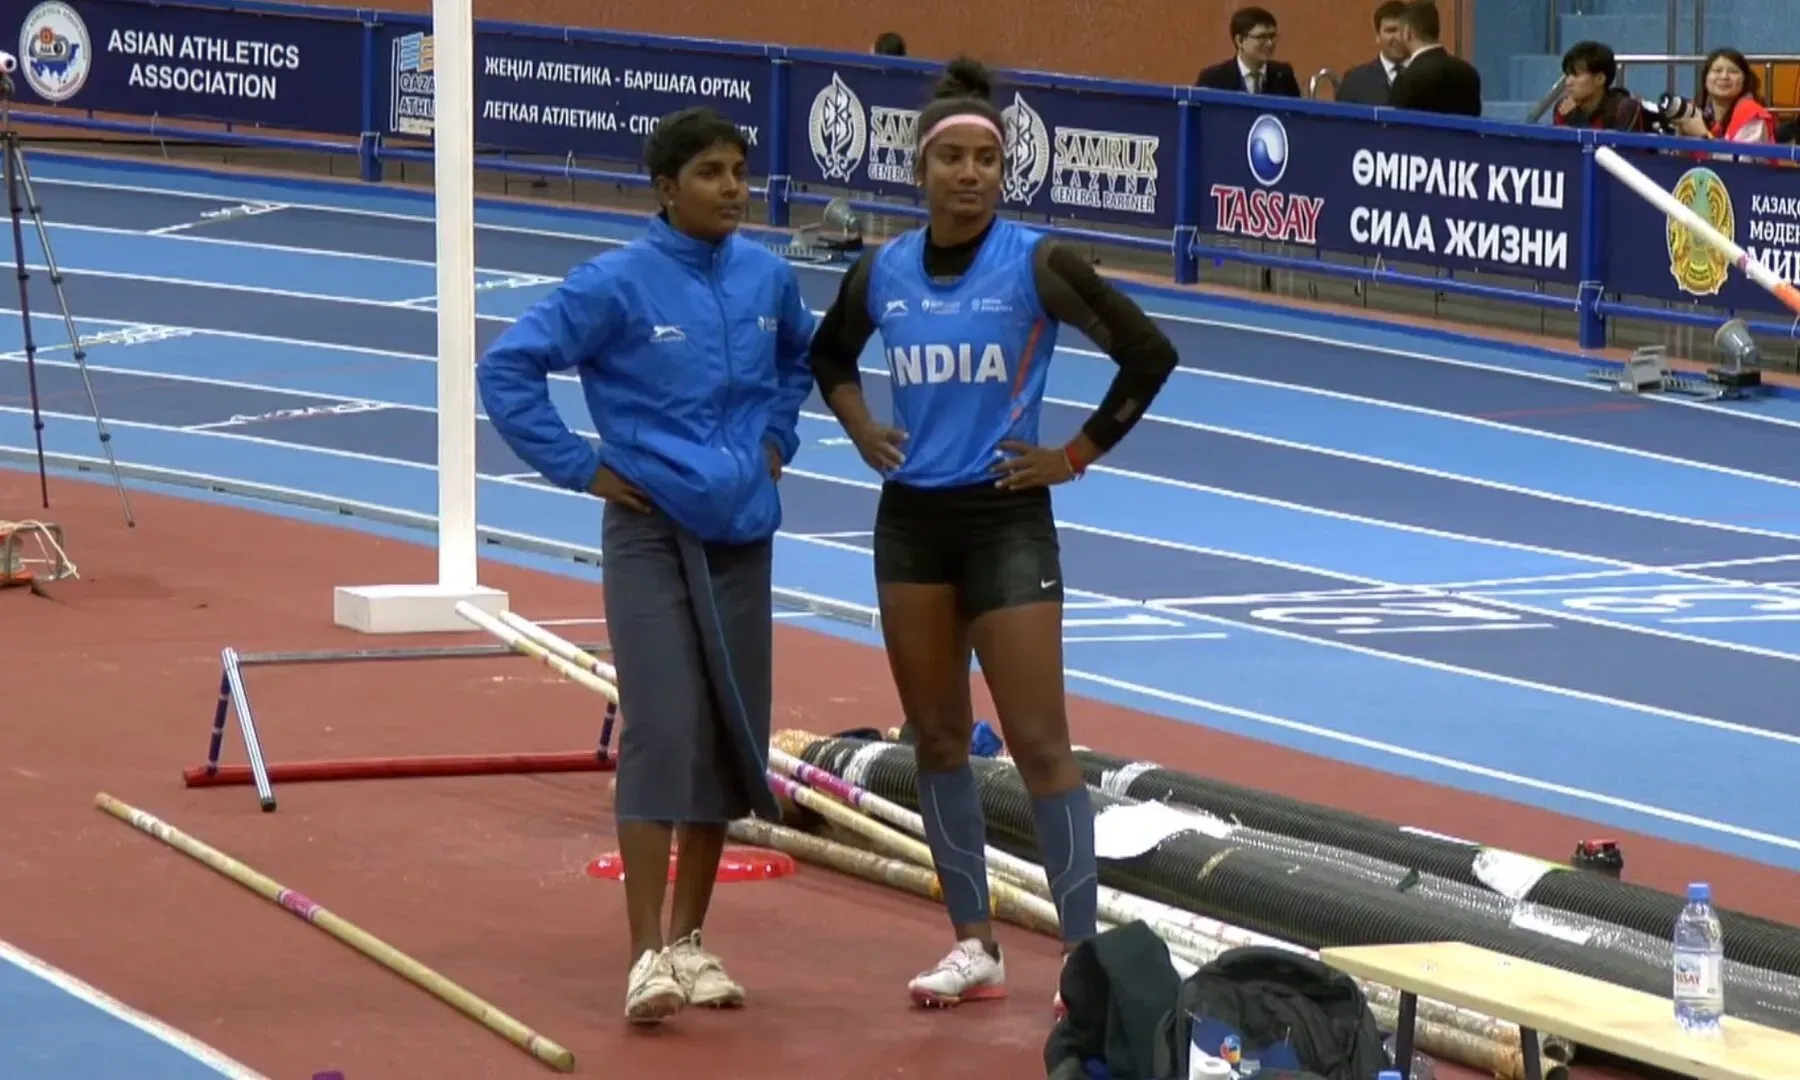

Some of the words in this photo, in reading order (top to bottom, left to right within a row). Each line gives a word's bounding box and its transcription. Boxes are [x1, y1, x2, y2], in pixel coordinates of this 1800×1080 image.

[107, 28, 174, 58] ASIAN
[179, 35, 300, 69] ATHLETICS
[128, 63, 277, 100] ASSOCIATION
[484, 56, 533, 82] ЖЕҢІЛ
[536, 61, 612, 87] АТЛЕТИКА
[624, 69, 697, 94] БАРШАҒА
[700, 76, 751, 104] ОРТАҚ
[483, 99, 539, 123] ЛЕГКАЯ
[542, 106, 617, 132] АТЛЕТИКА
[1055, 128, 1159, 176] SAMRUK
[1050, 185, 1101, 208] GENERAL
[1102, 190, 1155, 213] PARTNER
[1210, 184, 1324, 244] TASSAY
[1350, 206, 1436, 253] СИЛА
[1444, 217, 1567, 270] ЖИЗНИ
